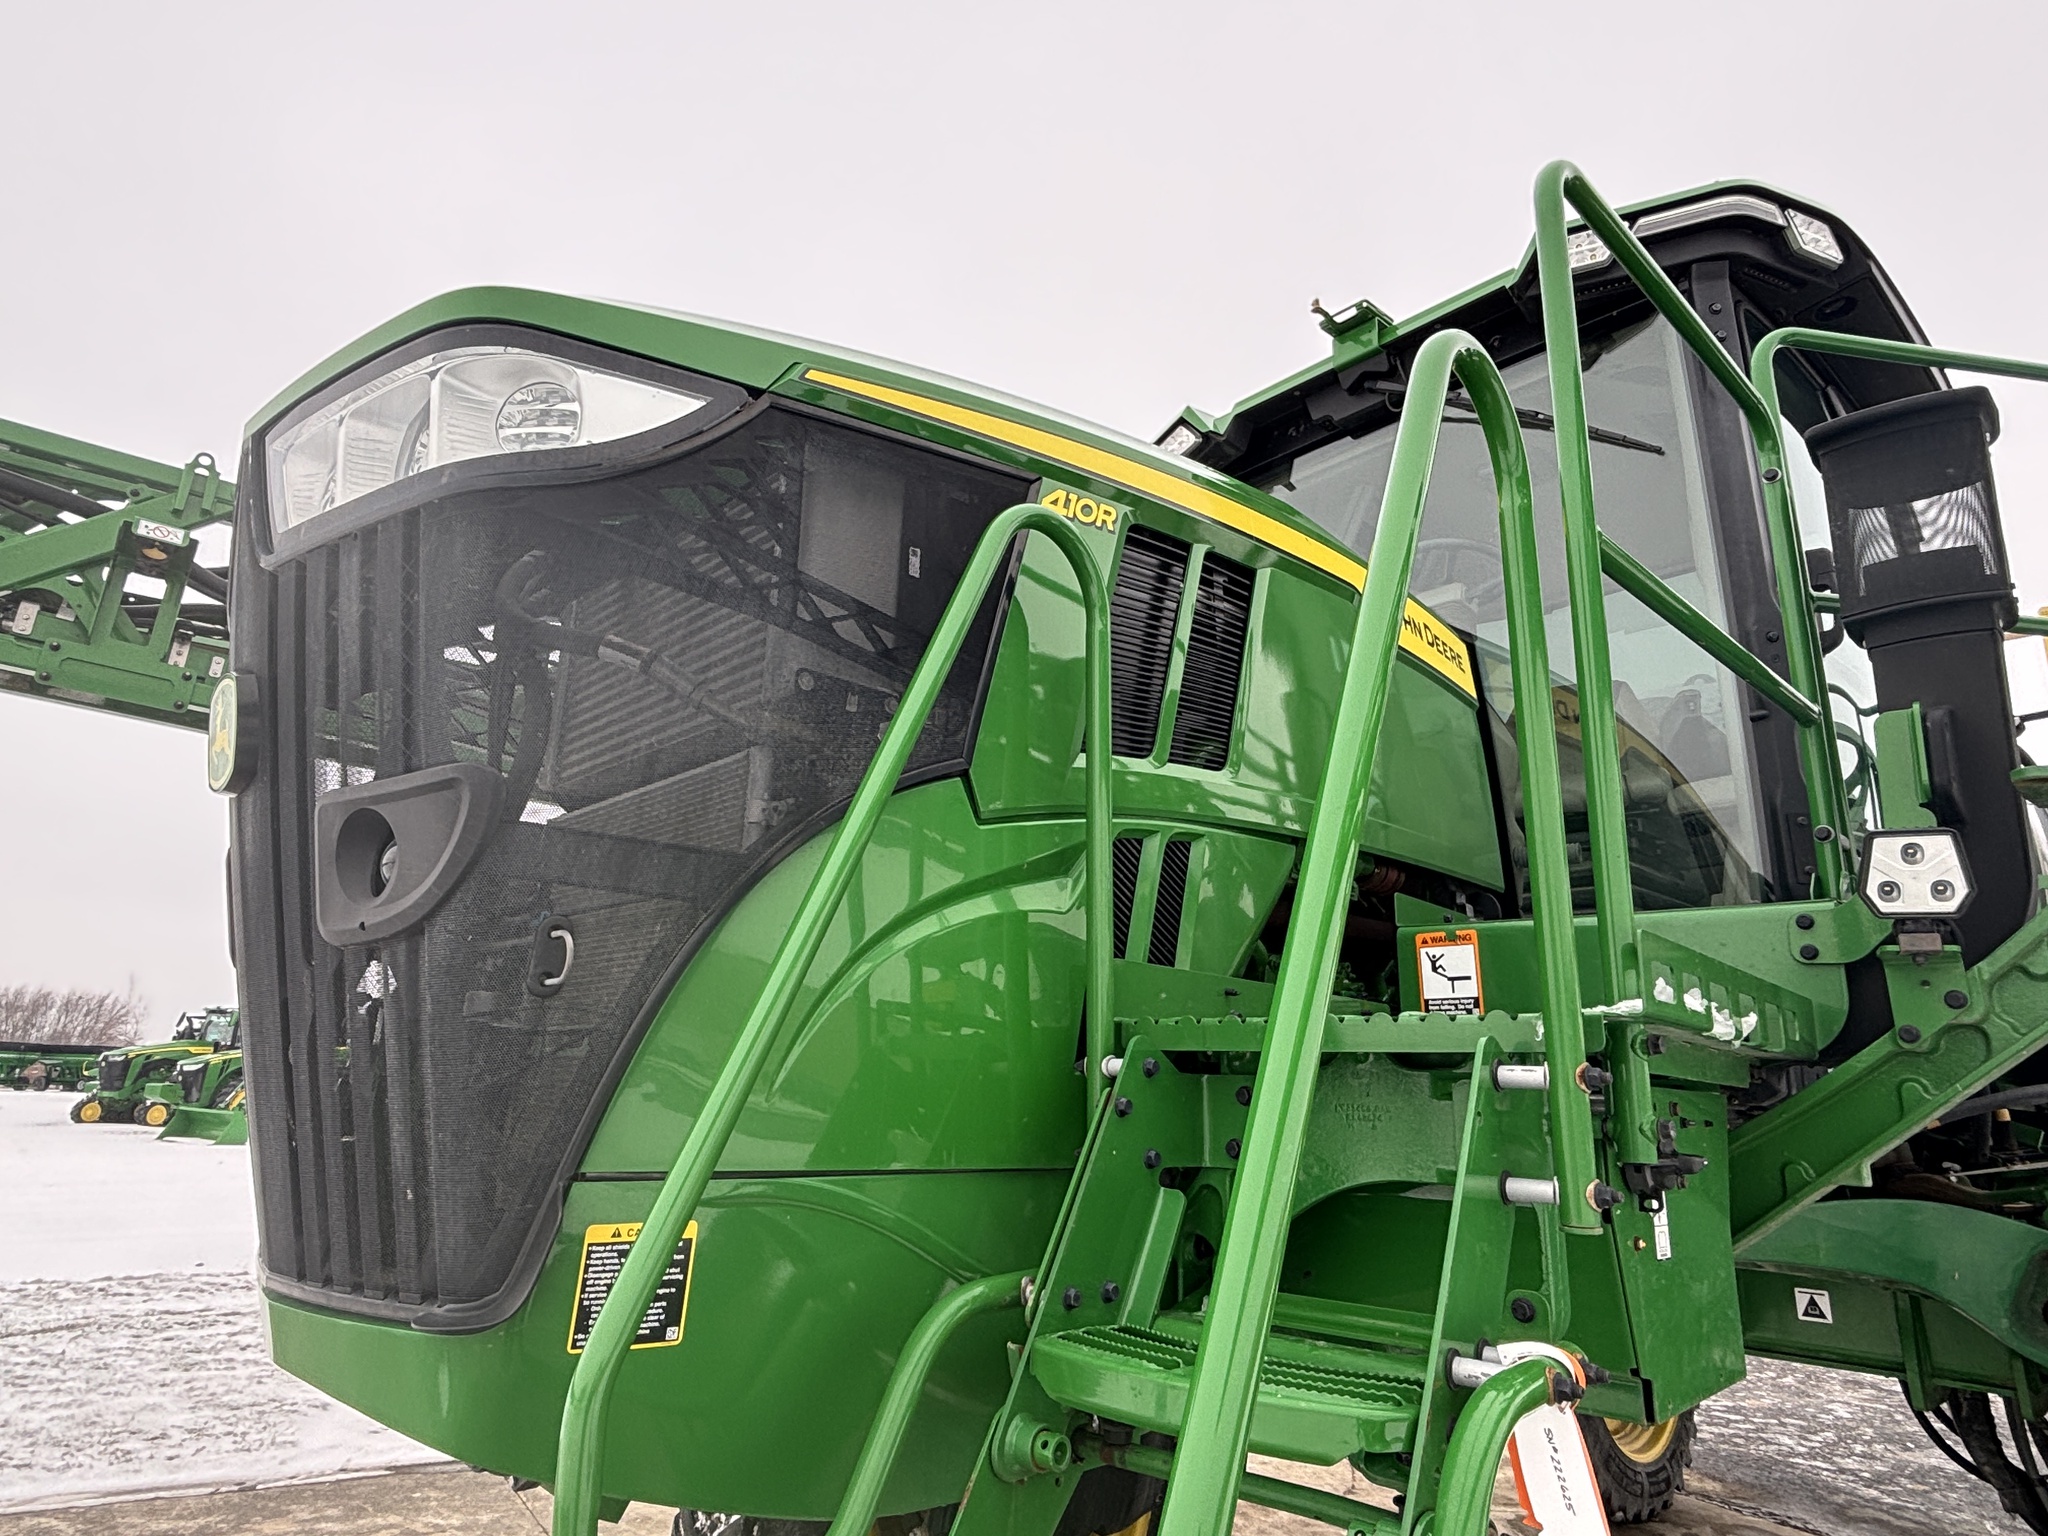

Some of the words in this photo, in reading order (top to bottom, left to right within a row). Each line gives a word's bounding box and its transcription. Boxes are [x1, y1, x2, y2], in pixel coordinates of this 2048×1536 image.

[1041, 489, 1118, 532] 410R
[1403, 615, 1424, 641] HN
[1423, 621, 1466, 674] DEERE
